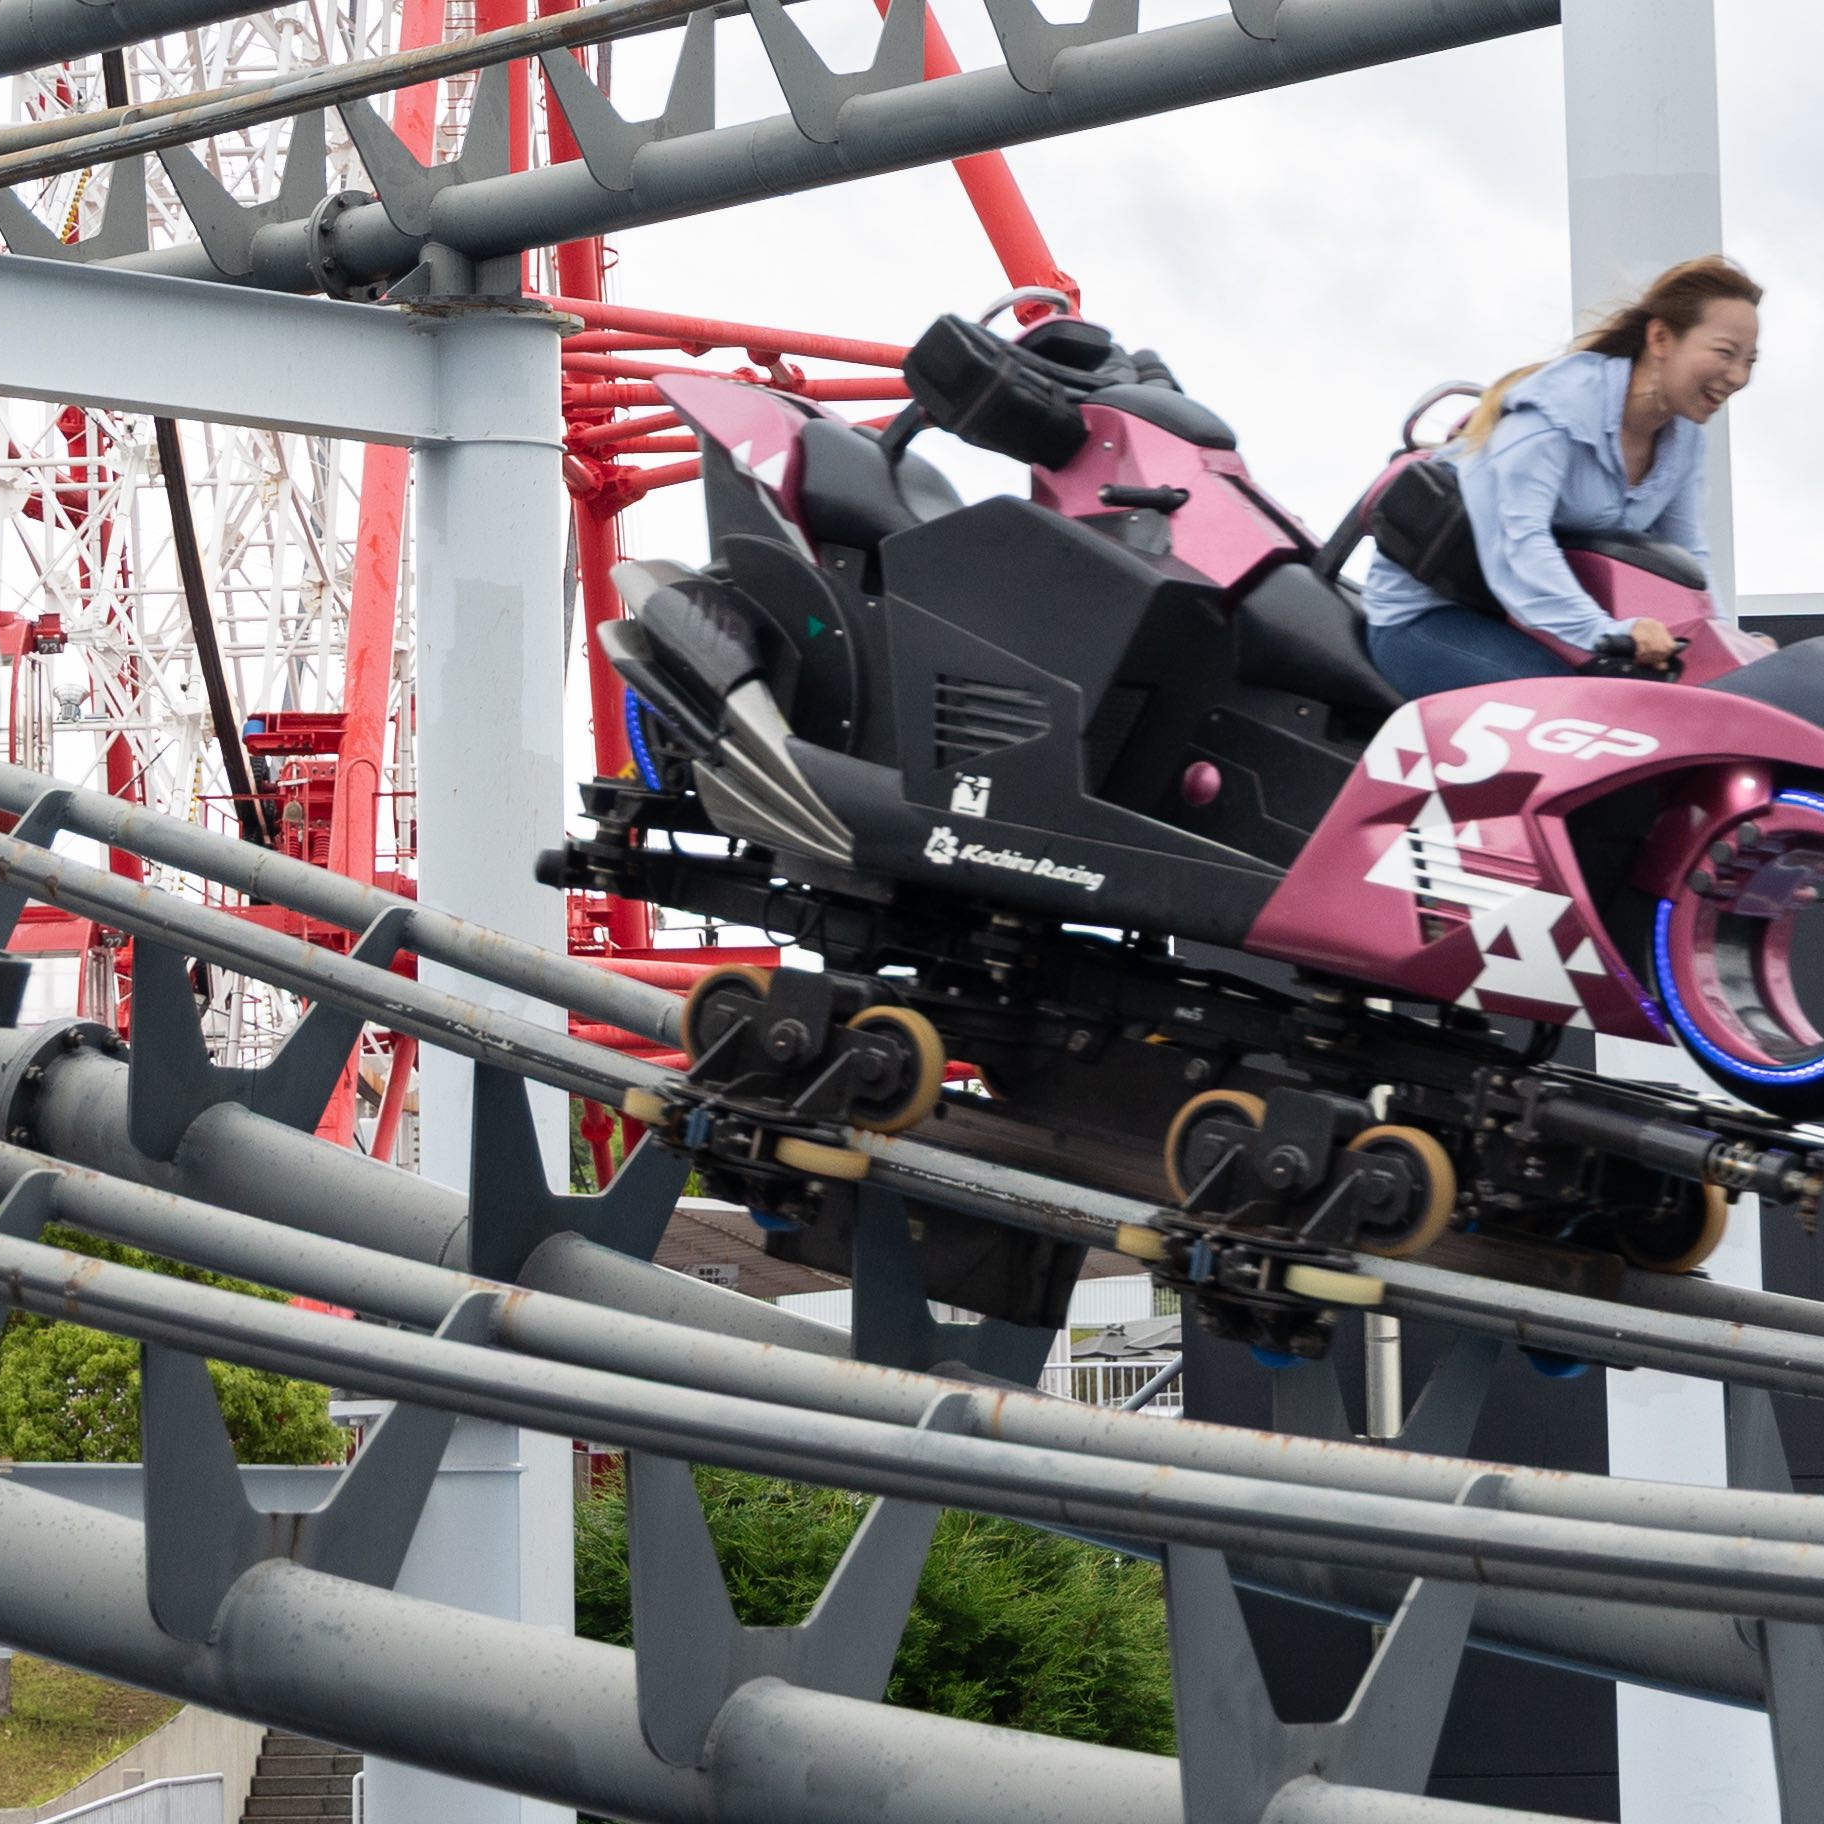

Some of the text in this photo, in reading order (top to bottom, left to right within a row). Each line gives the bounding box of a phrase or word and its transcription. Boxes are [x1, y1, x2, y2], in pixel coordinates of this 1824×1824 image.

[1434, 701, 1661, 785] 5 GP
[1033, 858, 1106, 892] Racing
